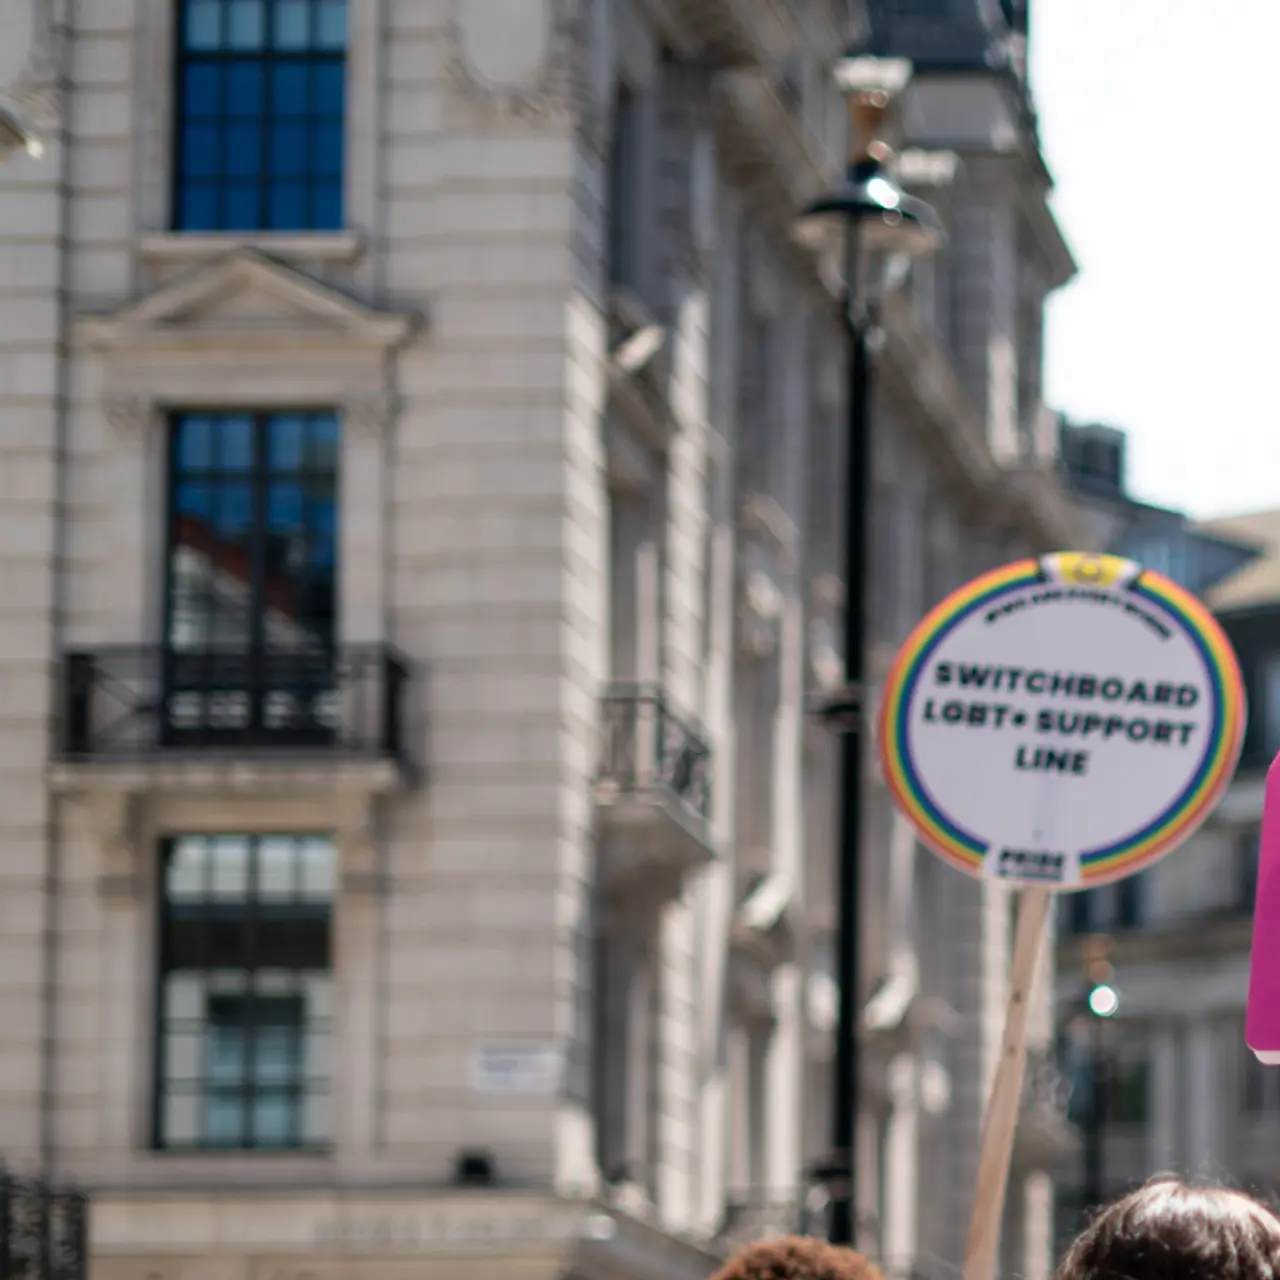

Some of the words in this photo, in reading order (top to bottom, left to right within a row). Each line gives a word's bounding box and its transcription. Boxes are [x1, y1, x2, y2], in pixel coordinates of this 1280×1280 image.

[935, 661, 1200, 709] SWITCHBOARD
[923, 697, 1028, 730] LGBT+
[1035, 709, 1196, 748] SUPPORT
[1014, 745, 1091, 776] LINE
